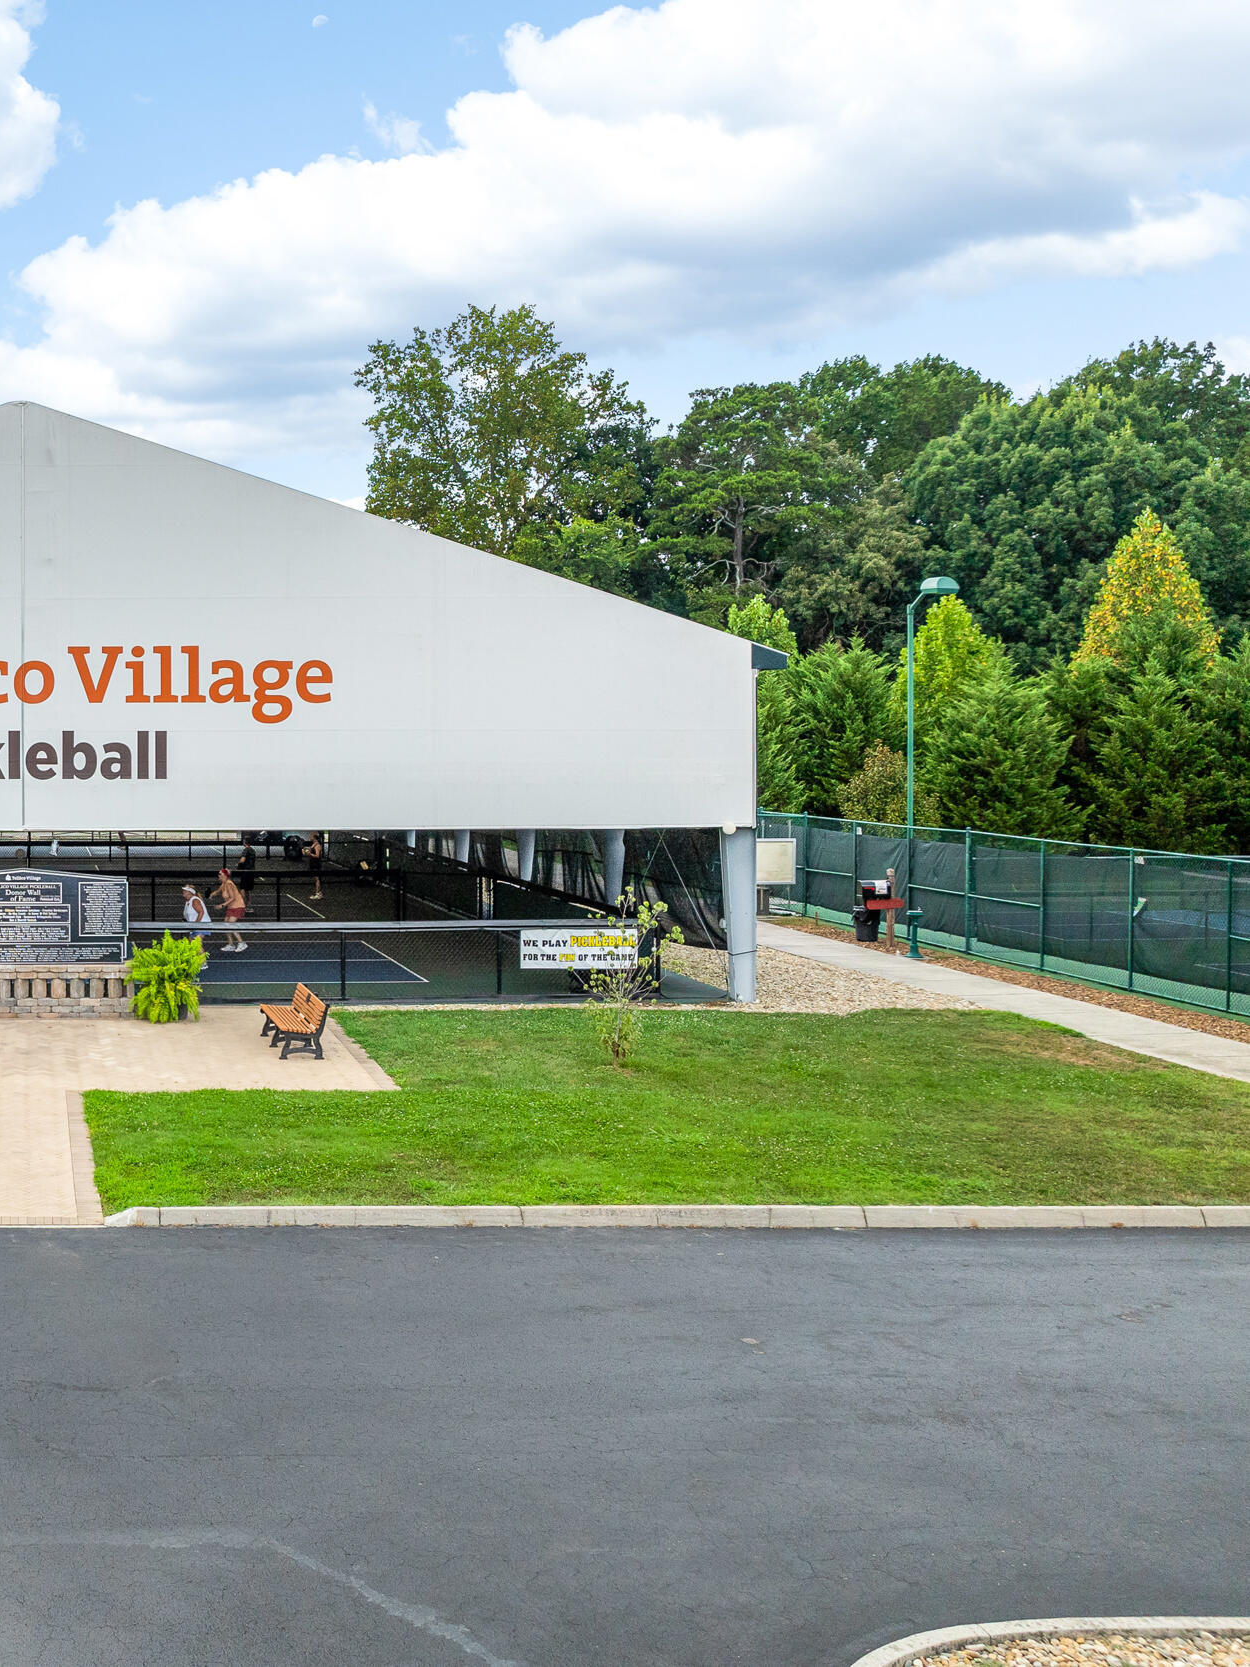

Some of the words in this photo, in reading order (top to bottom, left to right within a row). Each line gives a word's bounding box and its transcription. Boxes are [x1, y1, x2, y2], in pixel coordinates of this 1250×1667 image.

[68, 646, 333, 724] Village
[523, 939, 539, 947] WE
[542, 939, 568, 947] PLAY
[570, 935, 637, 947] PICKLEBALL
[522, 953, 539, 961] FOR
[540, 953, 557, 961] THE
[559, 953, 576, 962] FUN
[578, 953, 589, 961] OF
[591, 953, 608, 961] THE
